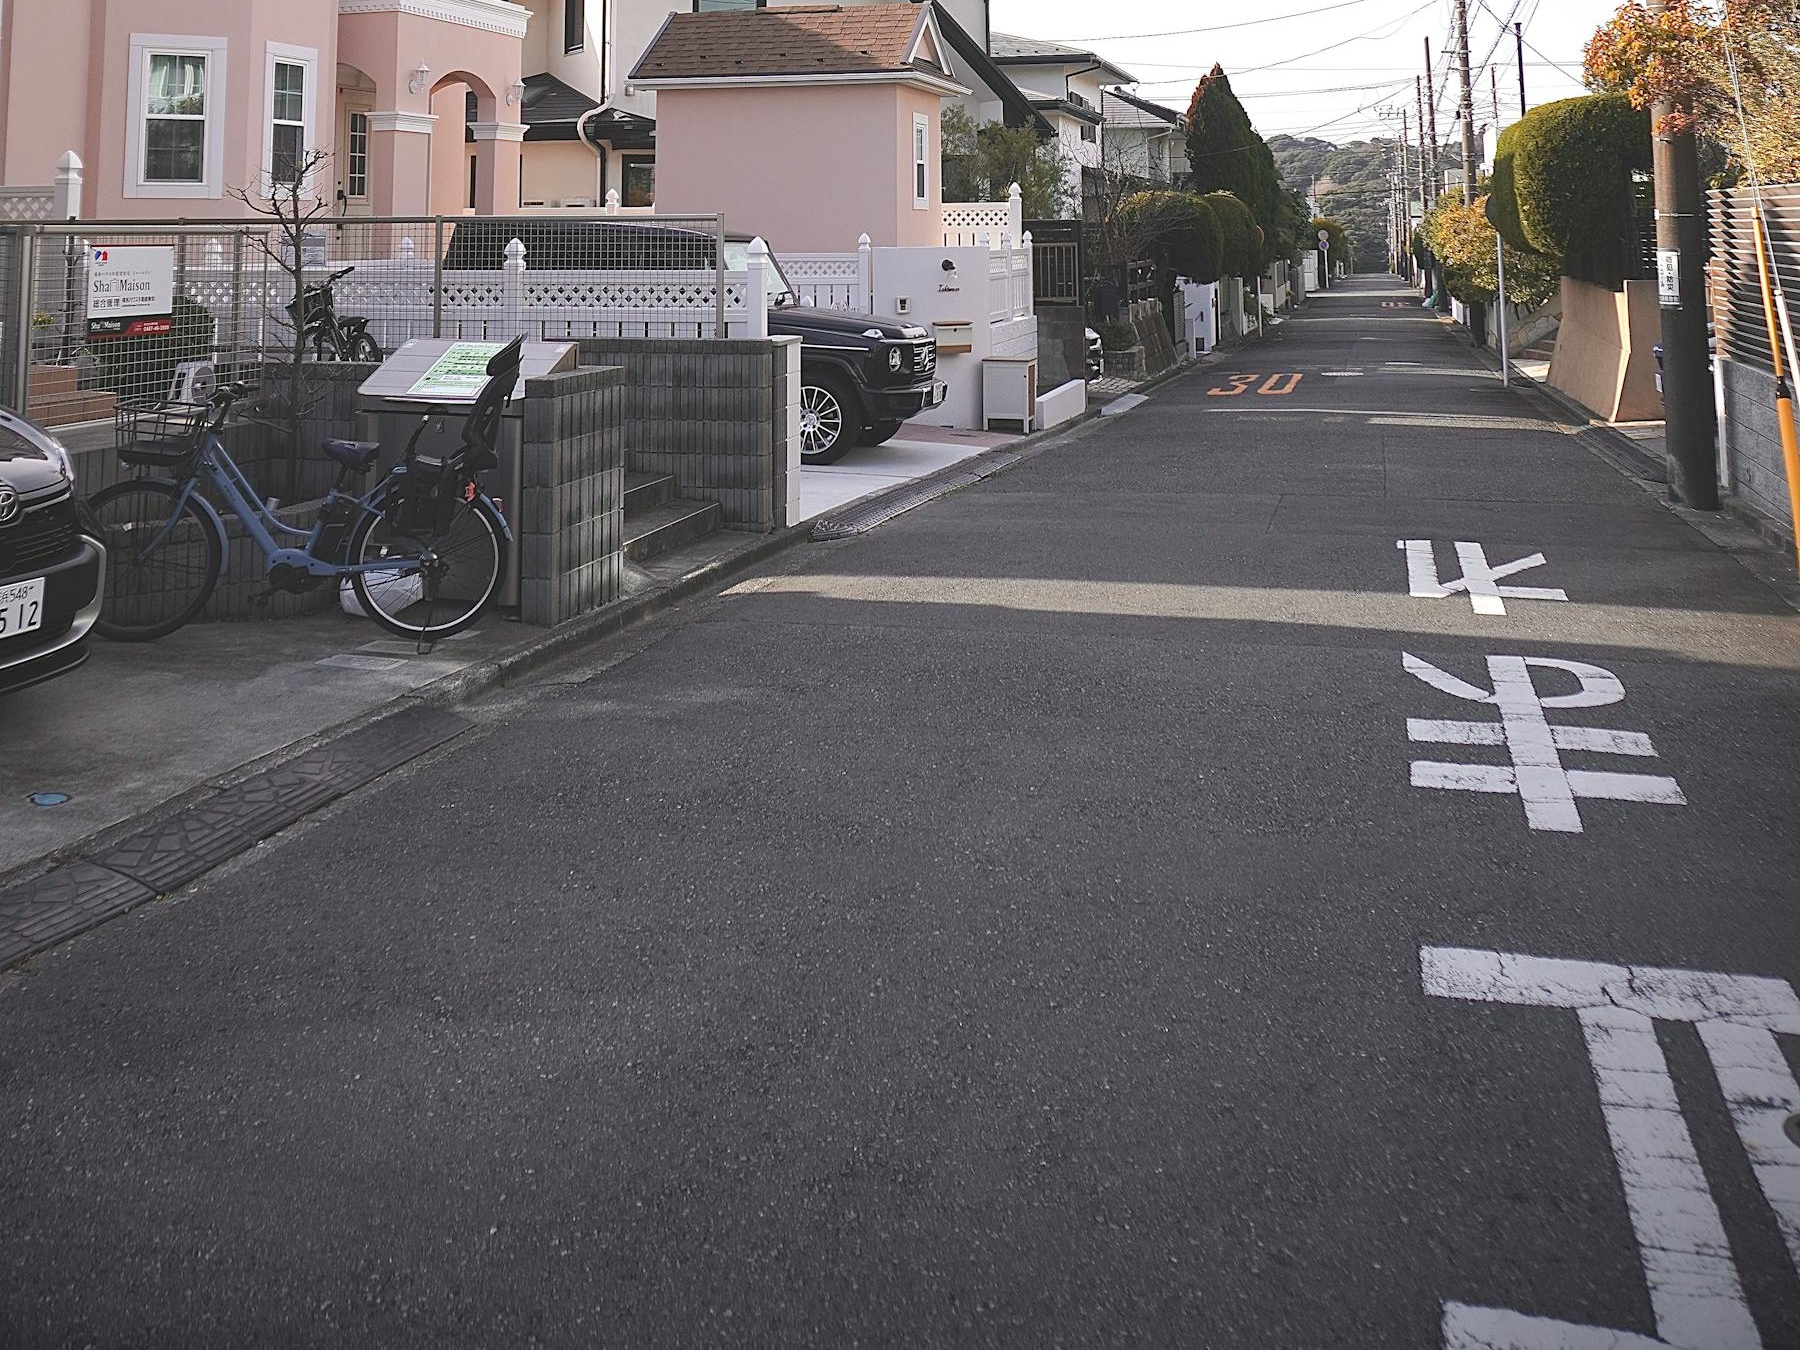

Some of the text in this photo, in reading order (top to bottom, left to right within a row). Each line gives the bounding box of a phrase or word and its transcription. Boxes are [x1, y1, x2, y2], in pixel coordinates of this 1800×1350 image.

[93, 279, 150, 293] Sha Maison
[1206, 373, 1304, 395] 30
